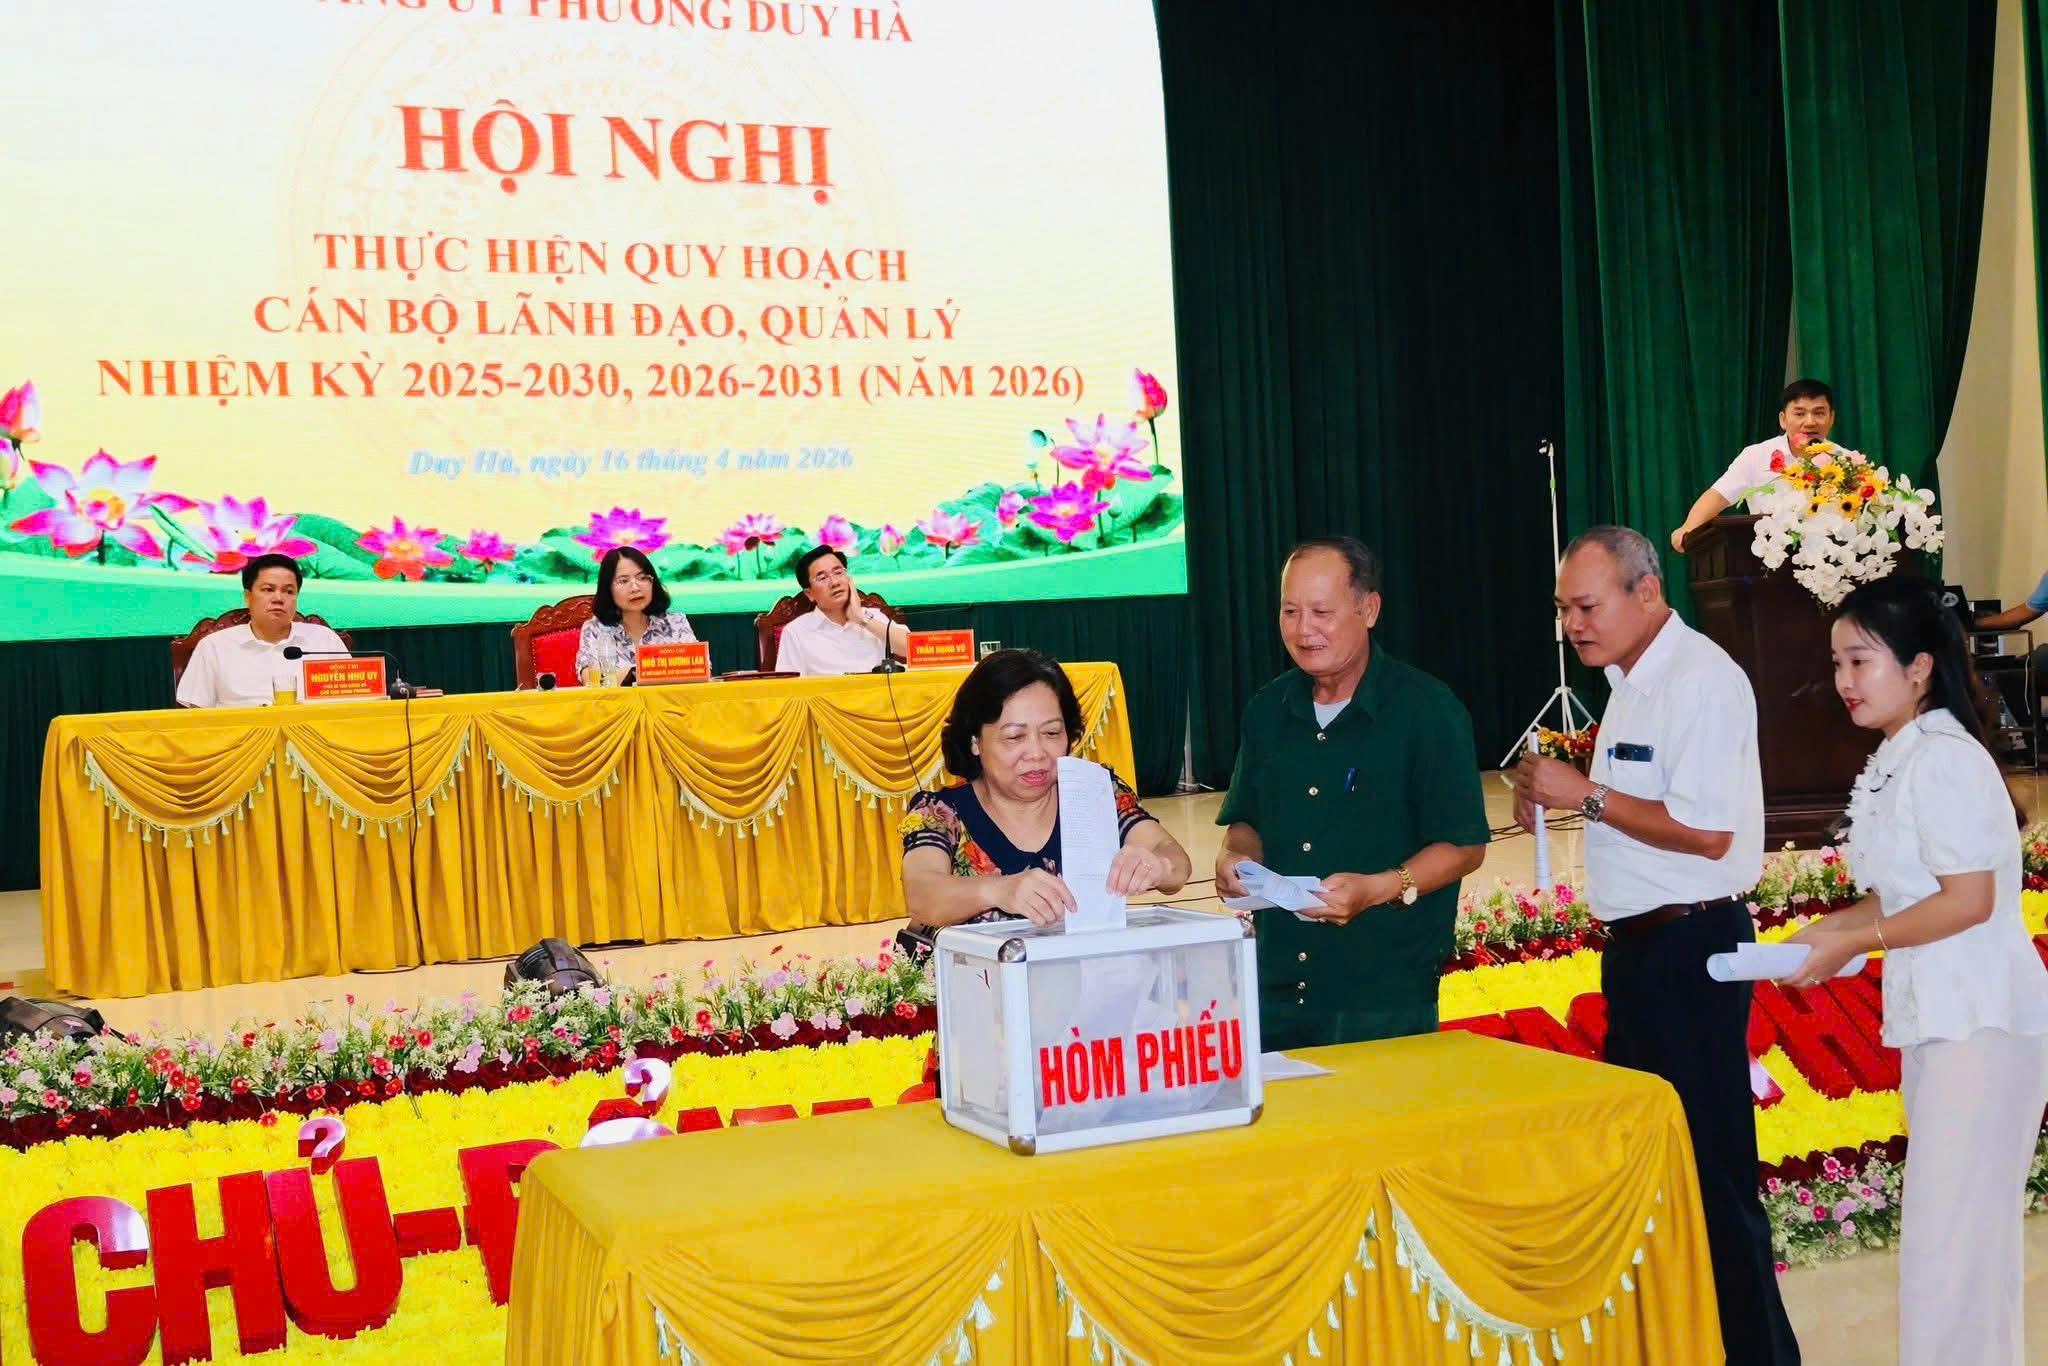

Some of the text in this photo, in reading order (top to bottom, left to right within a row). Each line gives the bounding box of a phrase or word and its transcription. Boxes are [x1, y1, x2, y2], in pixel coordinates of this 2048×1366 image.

[748, 0, 838, 37] DUY
[853, 0, 912, 42] HÀ
[395, 98, 834, 205] HỘI NGHỊ
[313, 231, 910, 289] THỰC HIỆN QUY HOẠCH
[254, 286, 961, 346] CÁN BỘ LÃNH ĐẠO, QUẢN LÝ
[97, 351, 1085, 407] NHIỆM KỲ 2025-2030, 2026-2031 (NĂM 2026)
[408, 450, 465, 479] Duy
[529, 450, 591, 478] ngày
[600, 449, 630, 472] 16
[716, 447, 731, 469] 4
[798, 447, 853, 469] 2026
[1040, 1026, 1126, 1108] HÒM
[1136, 1000, 1244, 1093] PHIẾU
